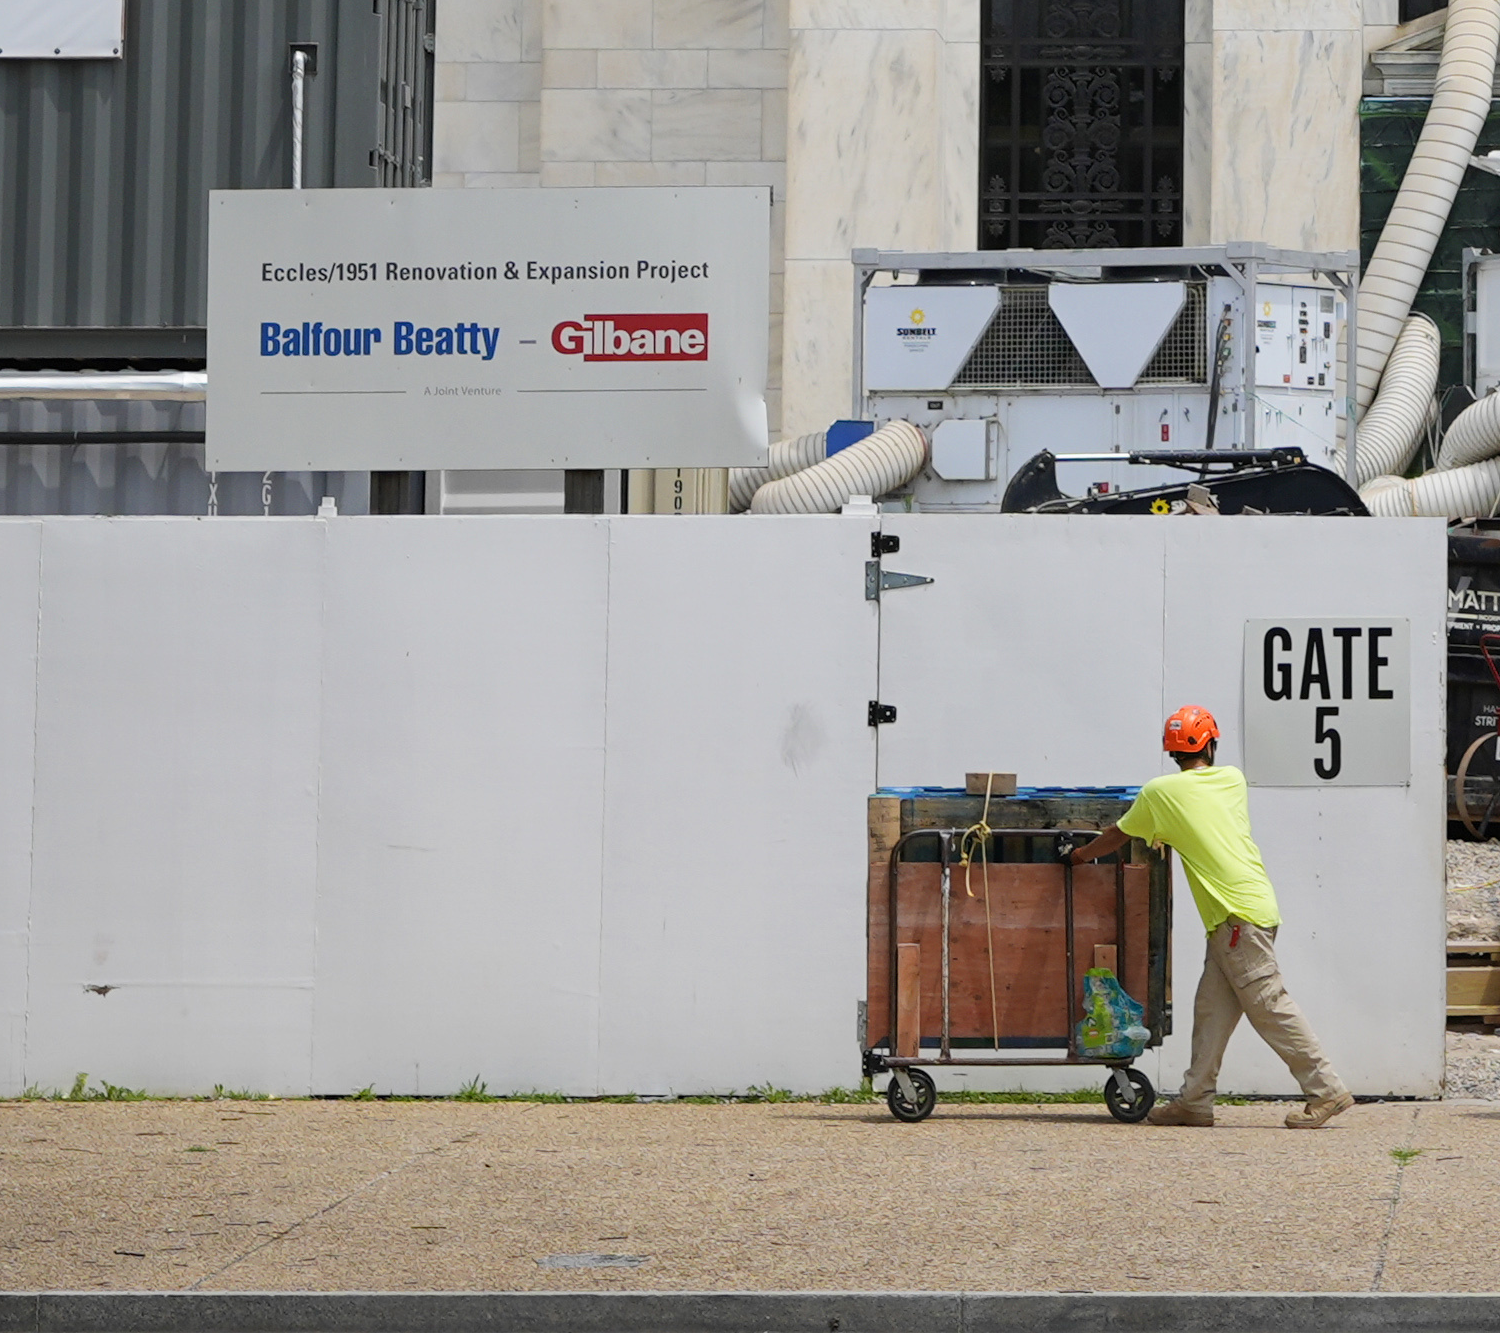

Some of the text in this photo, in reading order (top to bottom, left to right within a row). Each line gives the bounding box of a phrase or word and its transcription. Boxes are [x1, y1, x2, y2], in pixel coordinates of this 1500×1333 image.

[260, 259, 710, 285] Eccles/1951 Renovation & Expansion Project
[260, 315, 708, 361] Balfour Beatty Gilbane
[896, 327, 937, 336] SUNBELT
[423, 385, 502, 397] A Joint Venture
[1263, 626, 1394, 701] GATE
[1313, 705, 1342, 780] 5
